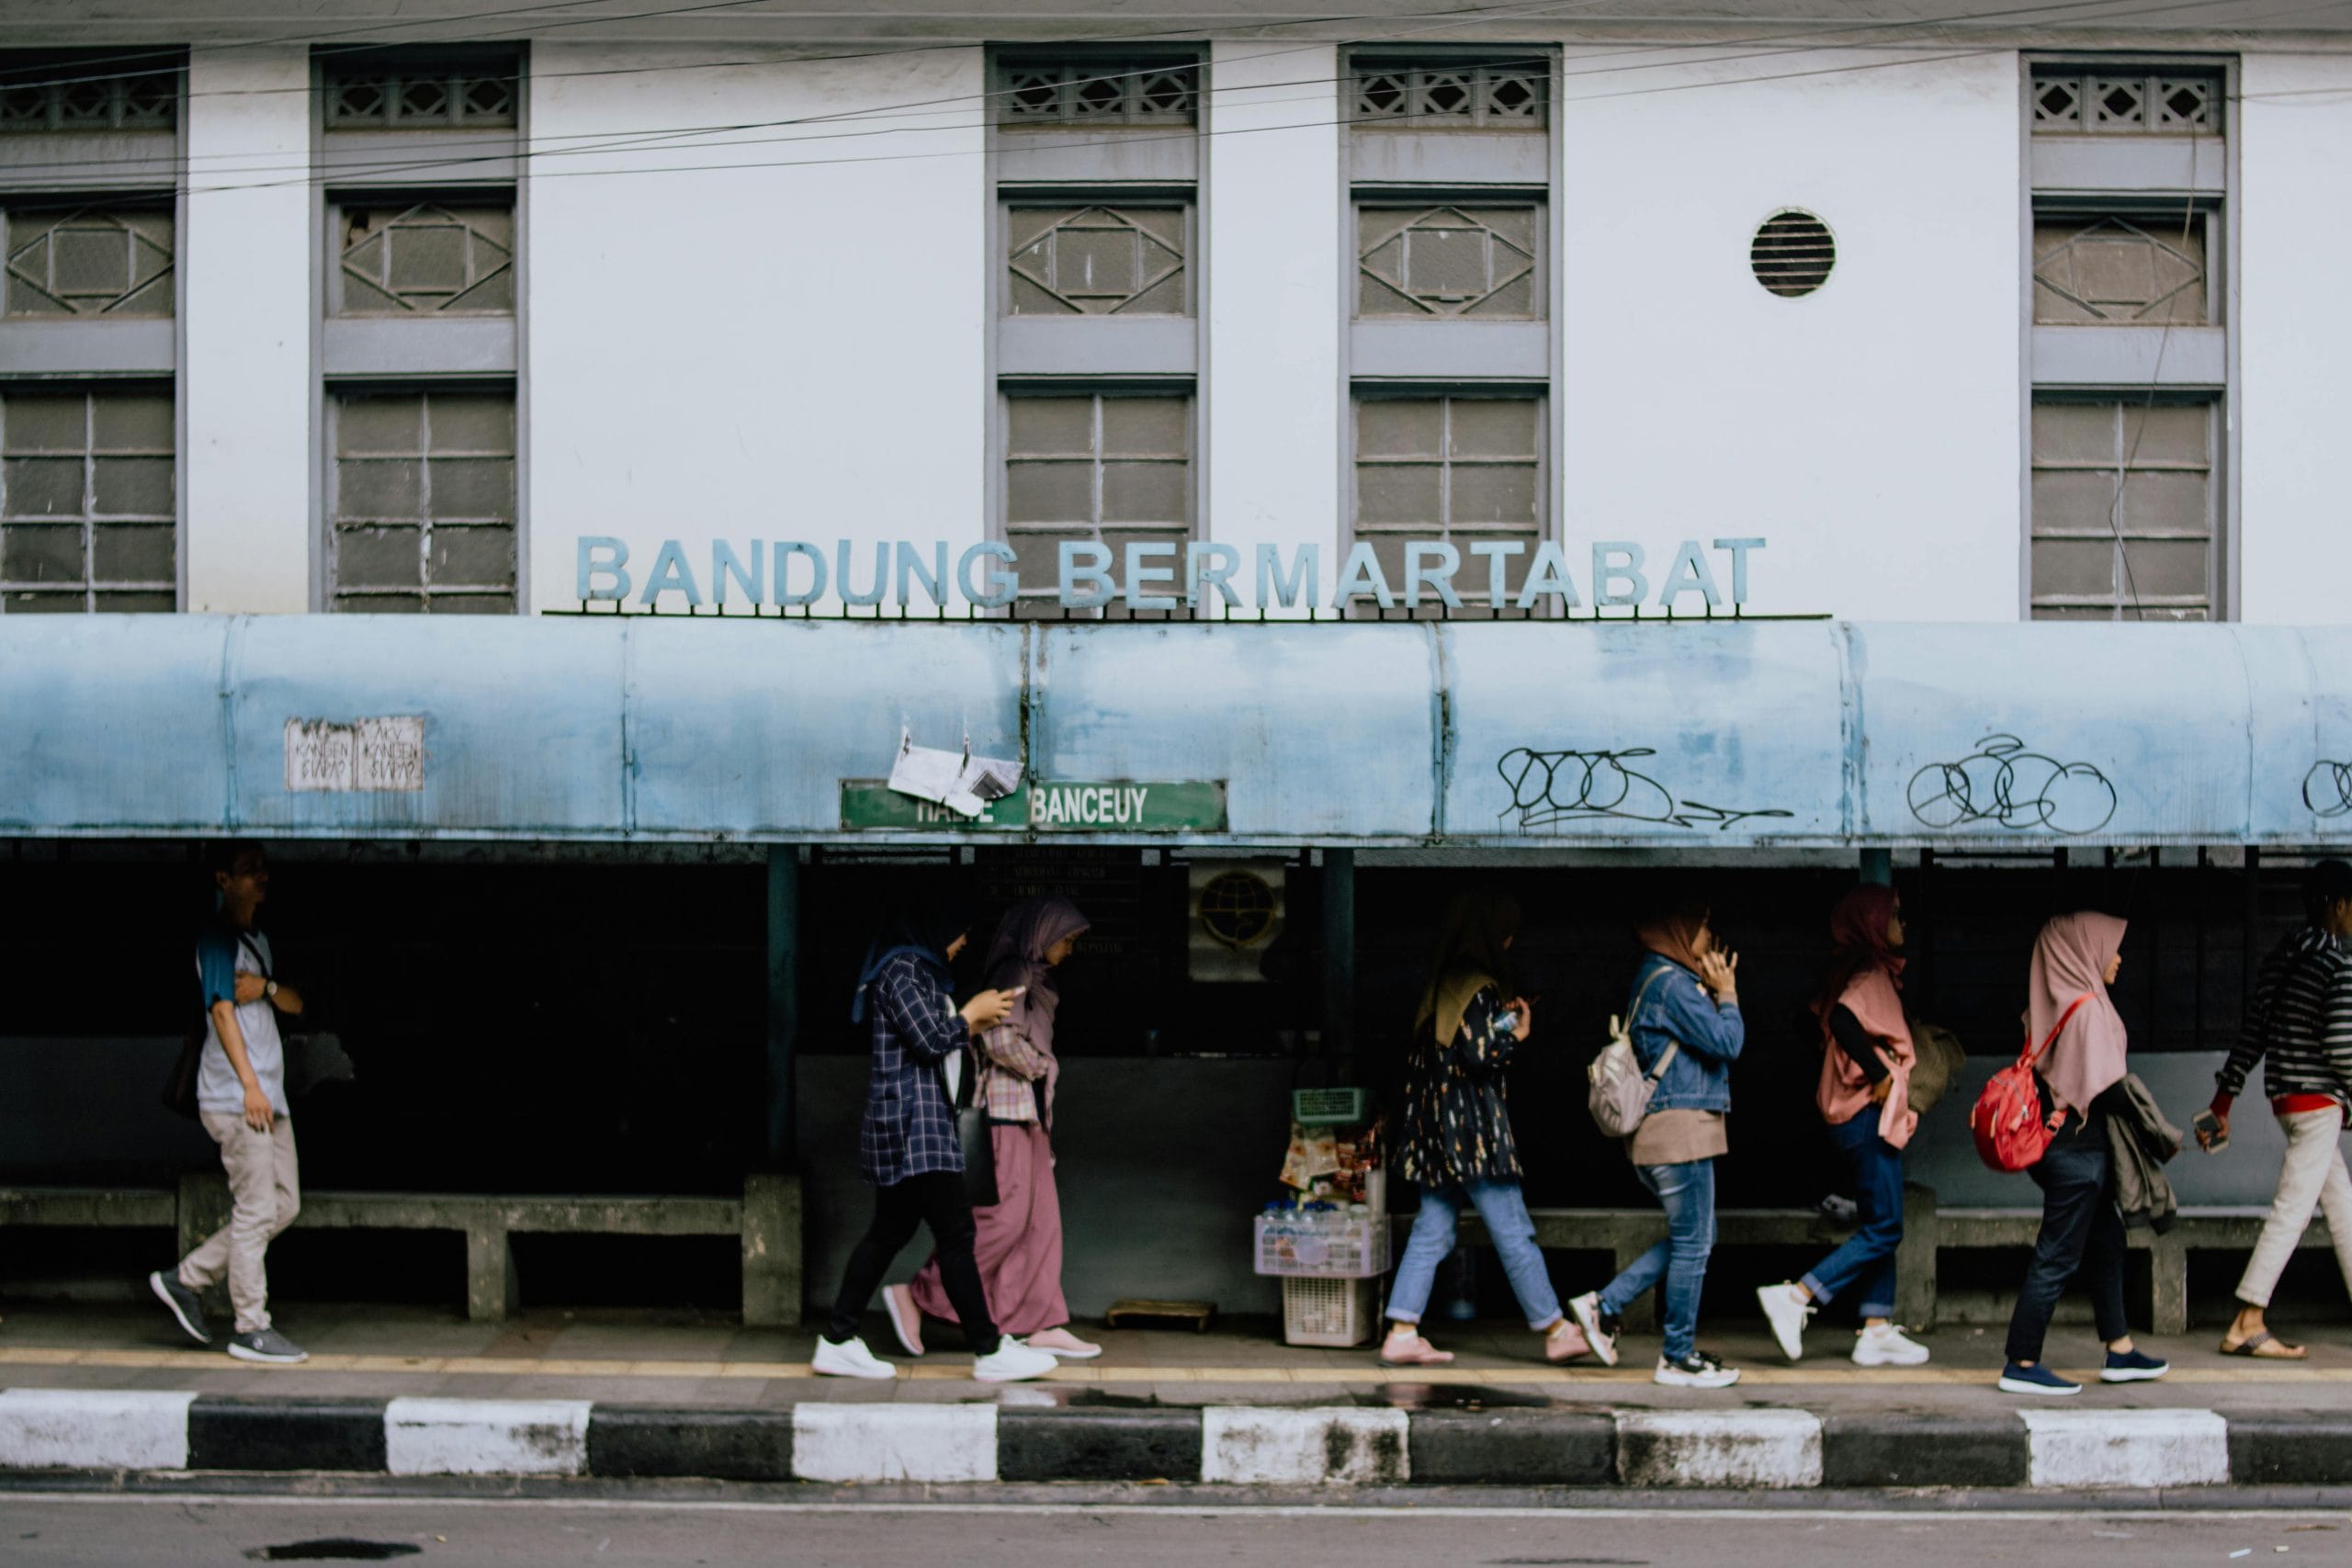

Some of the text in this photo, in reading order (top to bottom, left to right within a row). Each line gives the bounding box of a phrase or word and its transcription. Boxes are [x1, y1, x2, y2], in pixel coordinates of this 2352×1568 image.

[577, 536, 1767, 610] BANDUNG BERMARTABAT
[1030, 787, 1148, 824] BANCEUY
